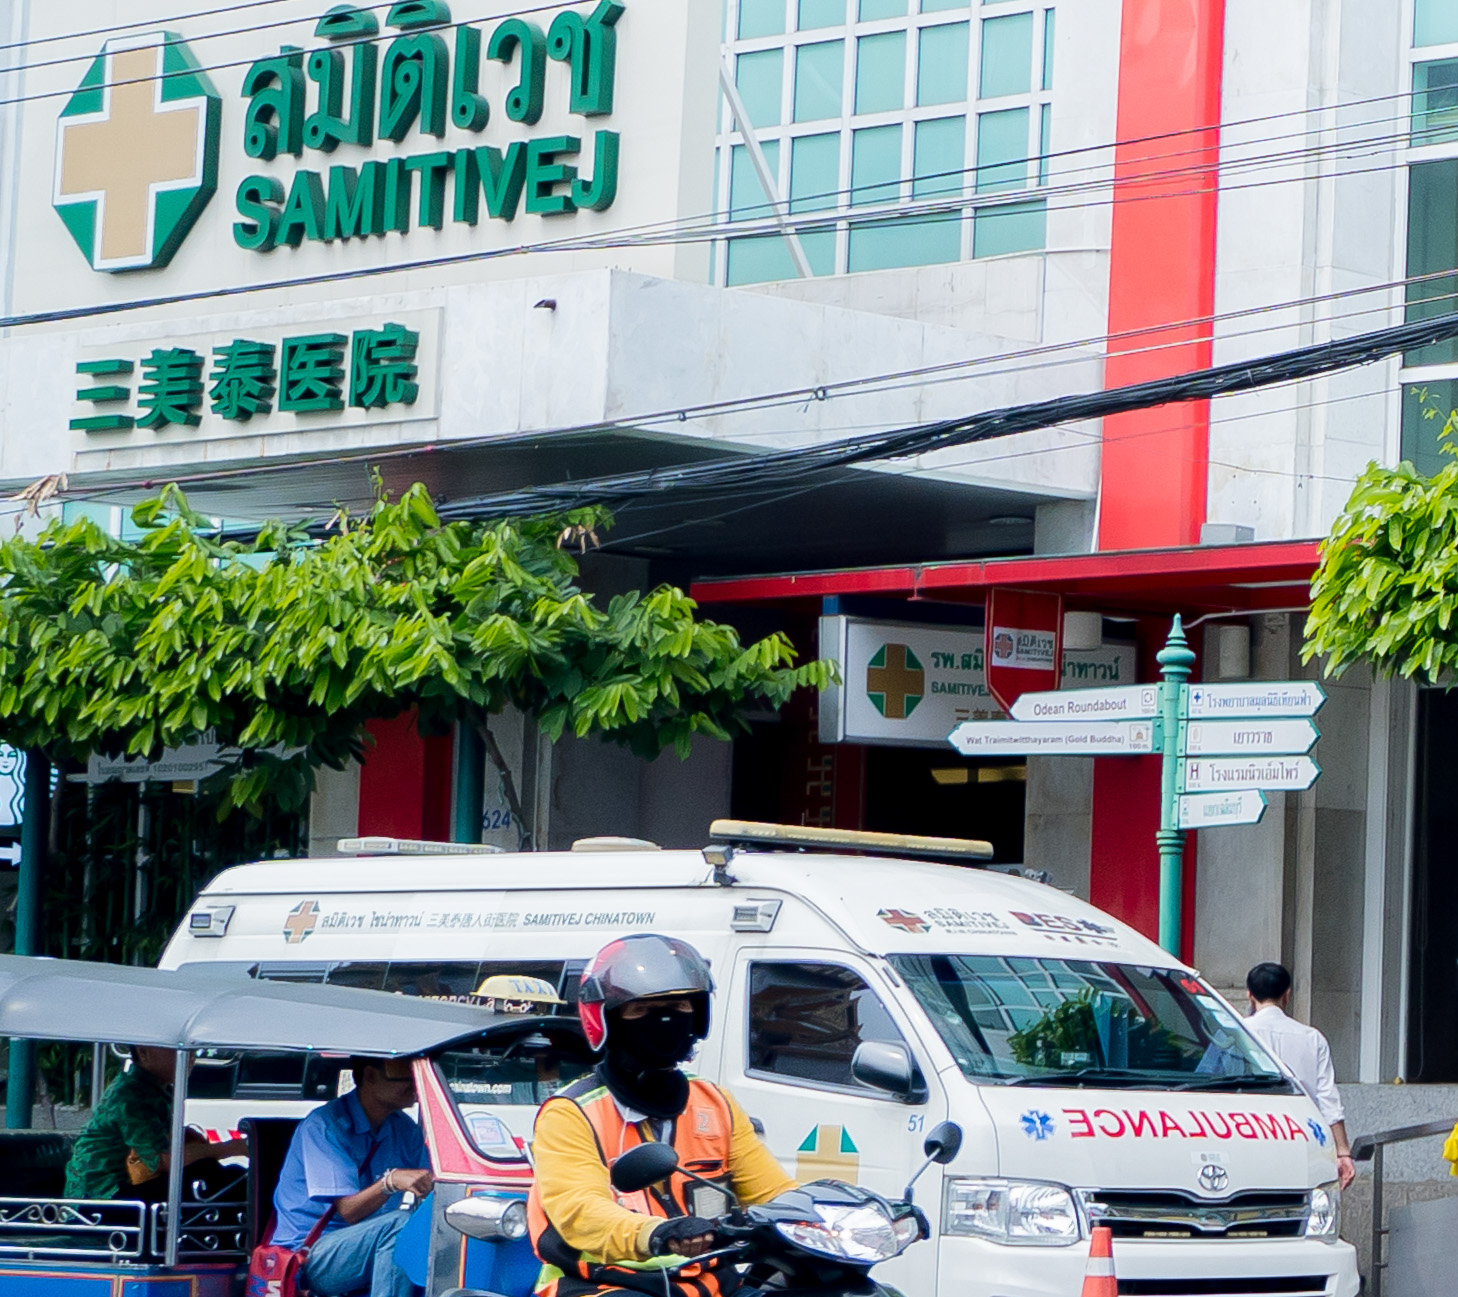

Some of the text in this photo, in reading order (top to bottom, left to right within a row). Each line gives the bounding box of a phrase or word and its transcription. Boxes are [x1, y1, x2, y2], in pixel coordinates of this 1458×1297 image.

[231, 130, 622, 253] SAMITIVEJ
[69, 321, 421, 433] 三美泰医院
[930, 648, 984, 671] รพ.สมิ
[1033, 698, 1127, 716] Odean Roundabout
[966, 735, 982, 745] Wat
[1065, 735, 1088, 746] (Gold
[1090, 735, 1125, 745] Buddha)
[1209, 761, 1299, 782] โรงแรมนิวเอ็มไพร์
[482, 809, 511, 830] 624
[321, 910, 425, 928] สมิติเวช ไชน่าทาวน์
[523, 911, 656, 927] SAMITIVEJ CHINATOWN
[907, 1114, 925, 1132] 51
